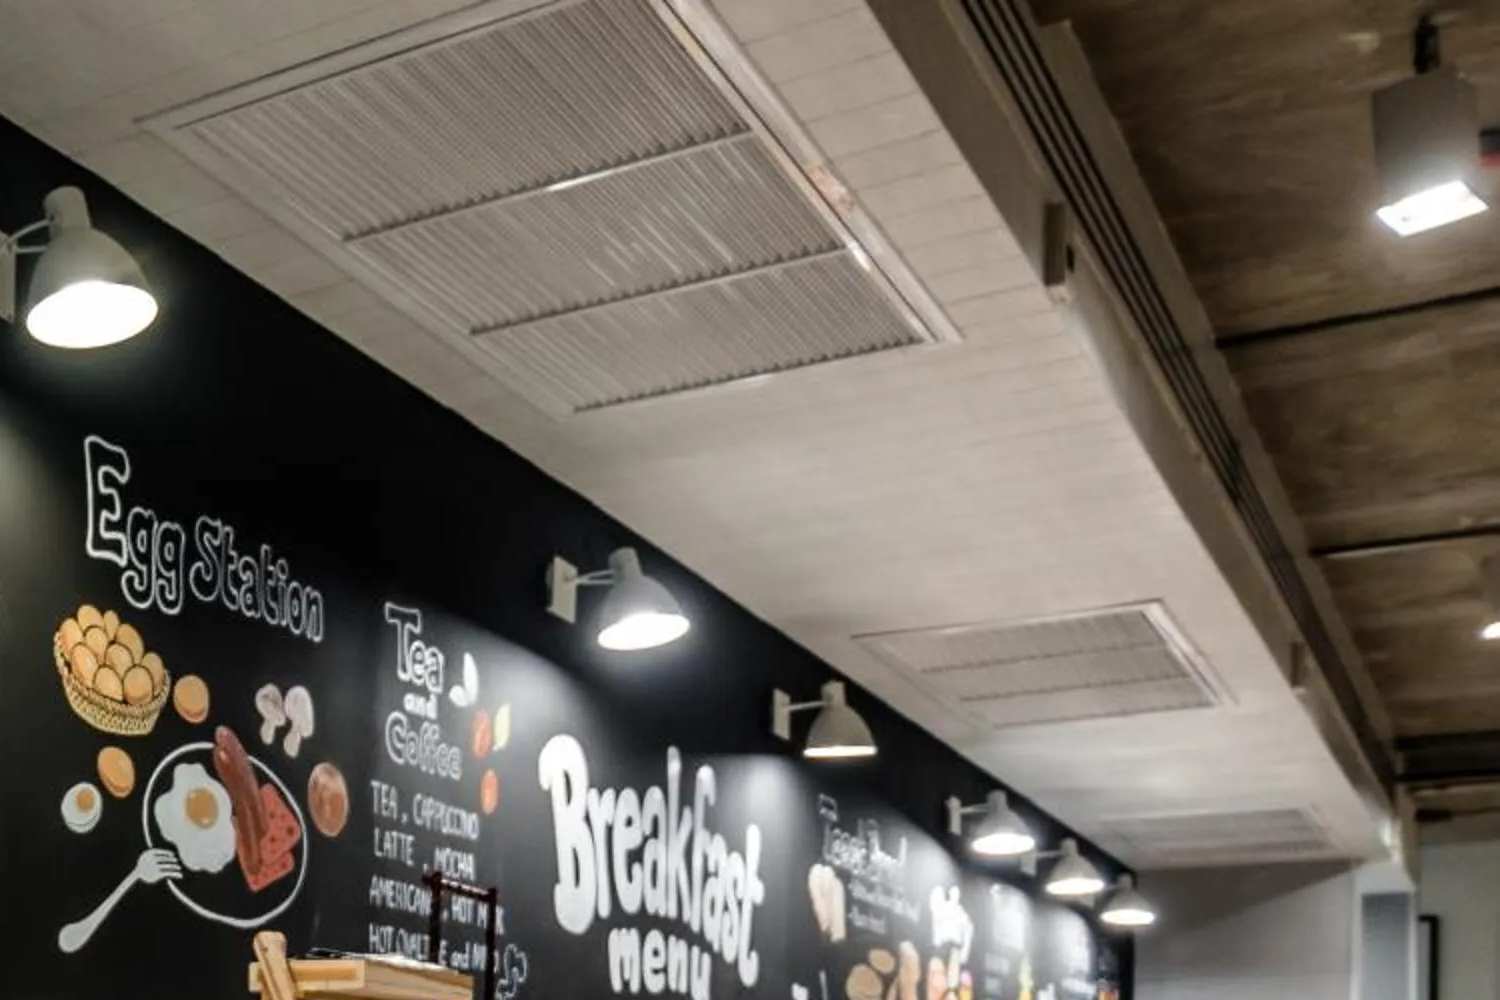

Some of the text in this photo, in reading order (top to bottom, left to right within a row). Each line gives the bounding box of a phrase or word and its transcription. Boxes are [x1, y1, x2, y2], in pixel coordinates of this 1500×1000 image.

[84, 435, 324, 643] Egg Station
[385, 601, 444, 694] Tea
[385, 710, 462, 782] Coffee
[433, 847, 476, 881] MOCHA
[538, 734, 764, 987] Breakfast
